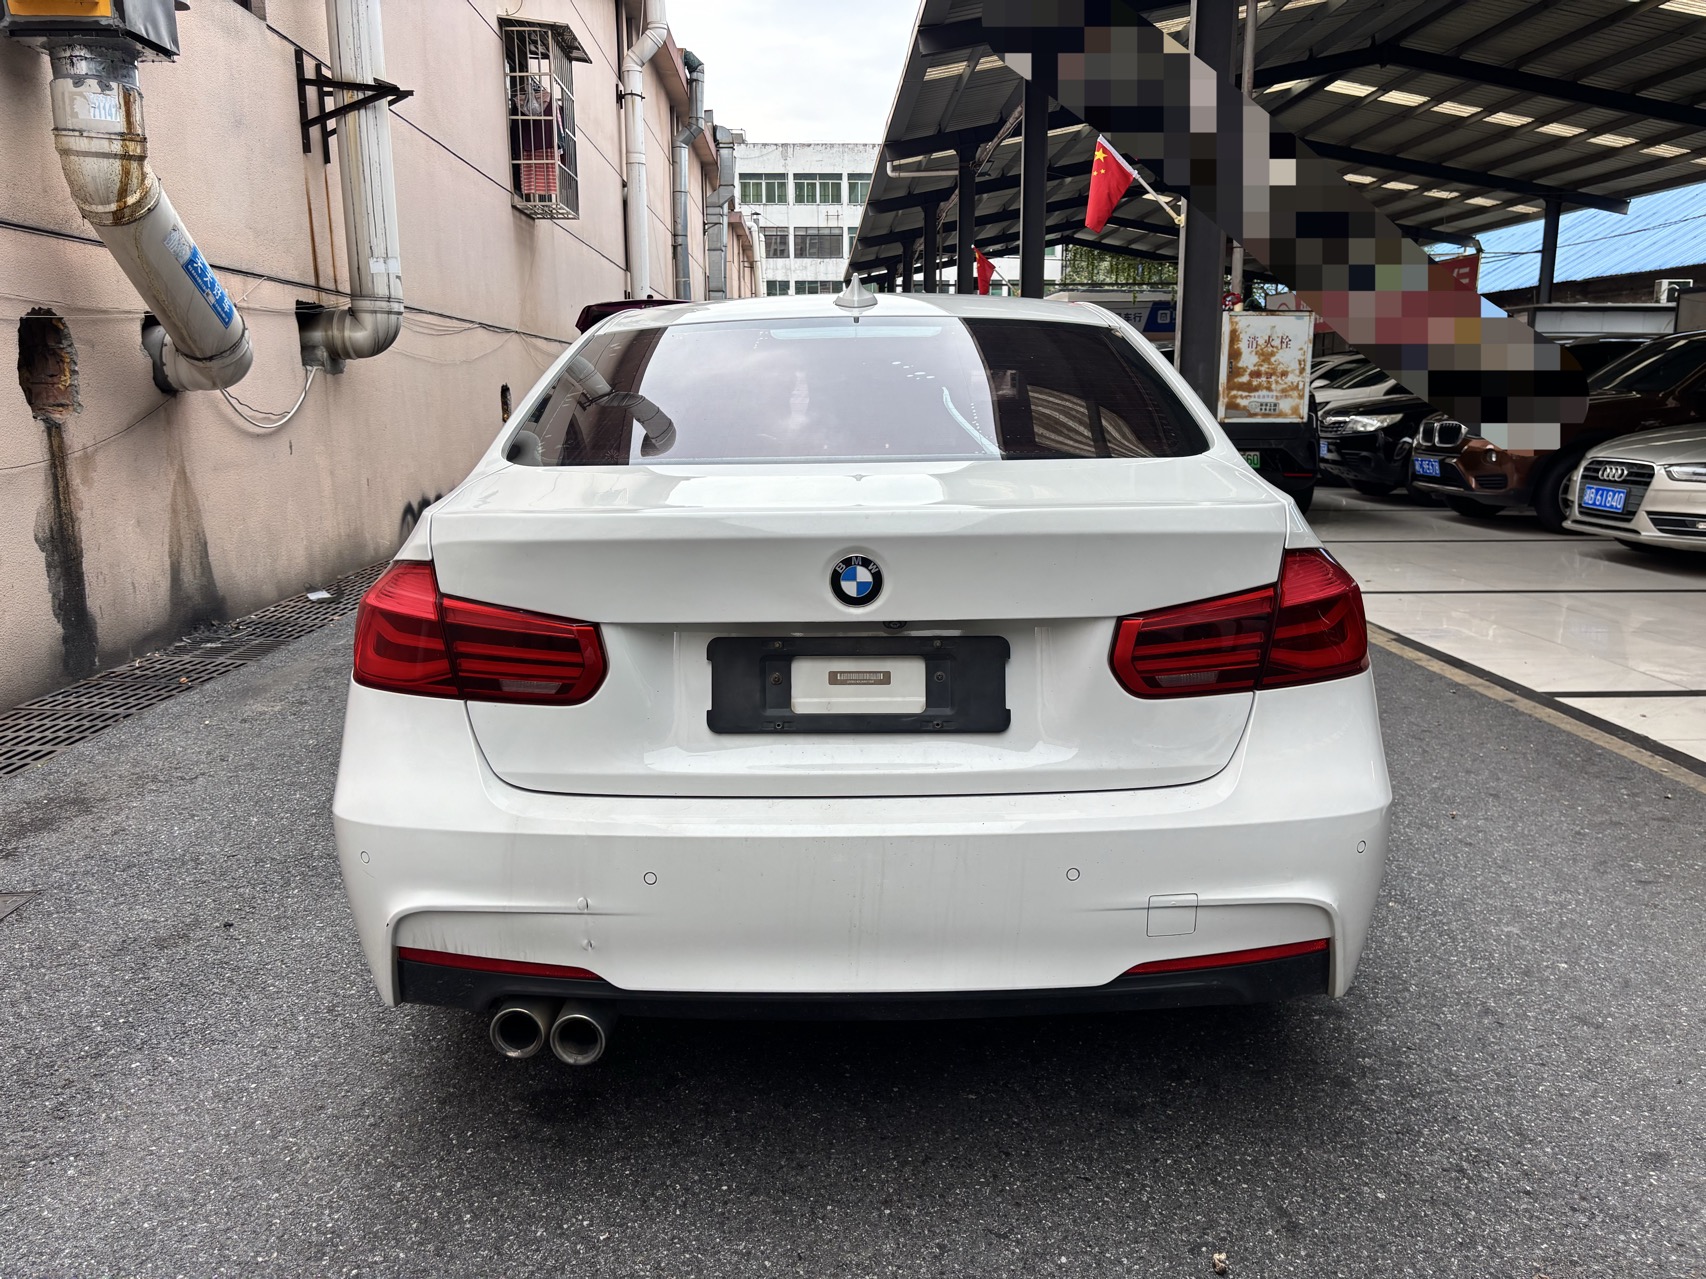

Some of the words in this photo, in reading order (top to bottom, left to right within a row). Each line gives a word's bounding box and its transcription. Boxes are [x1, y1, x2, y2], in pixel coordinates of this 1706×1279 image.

[1246, 335, 1293, 350] 消火栓
[835, 556, 879, 574] BMW
